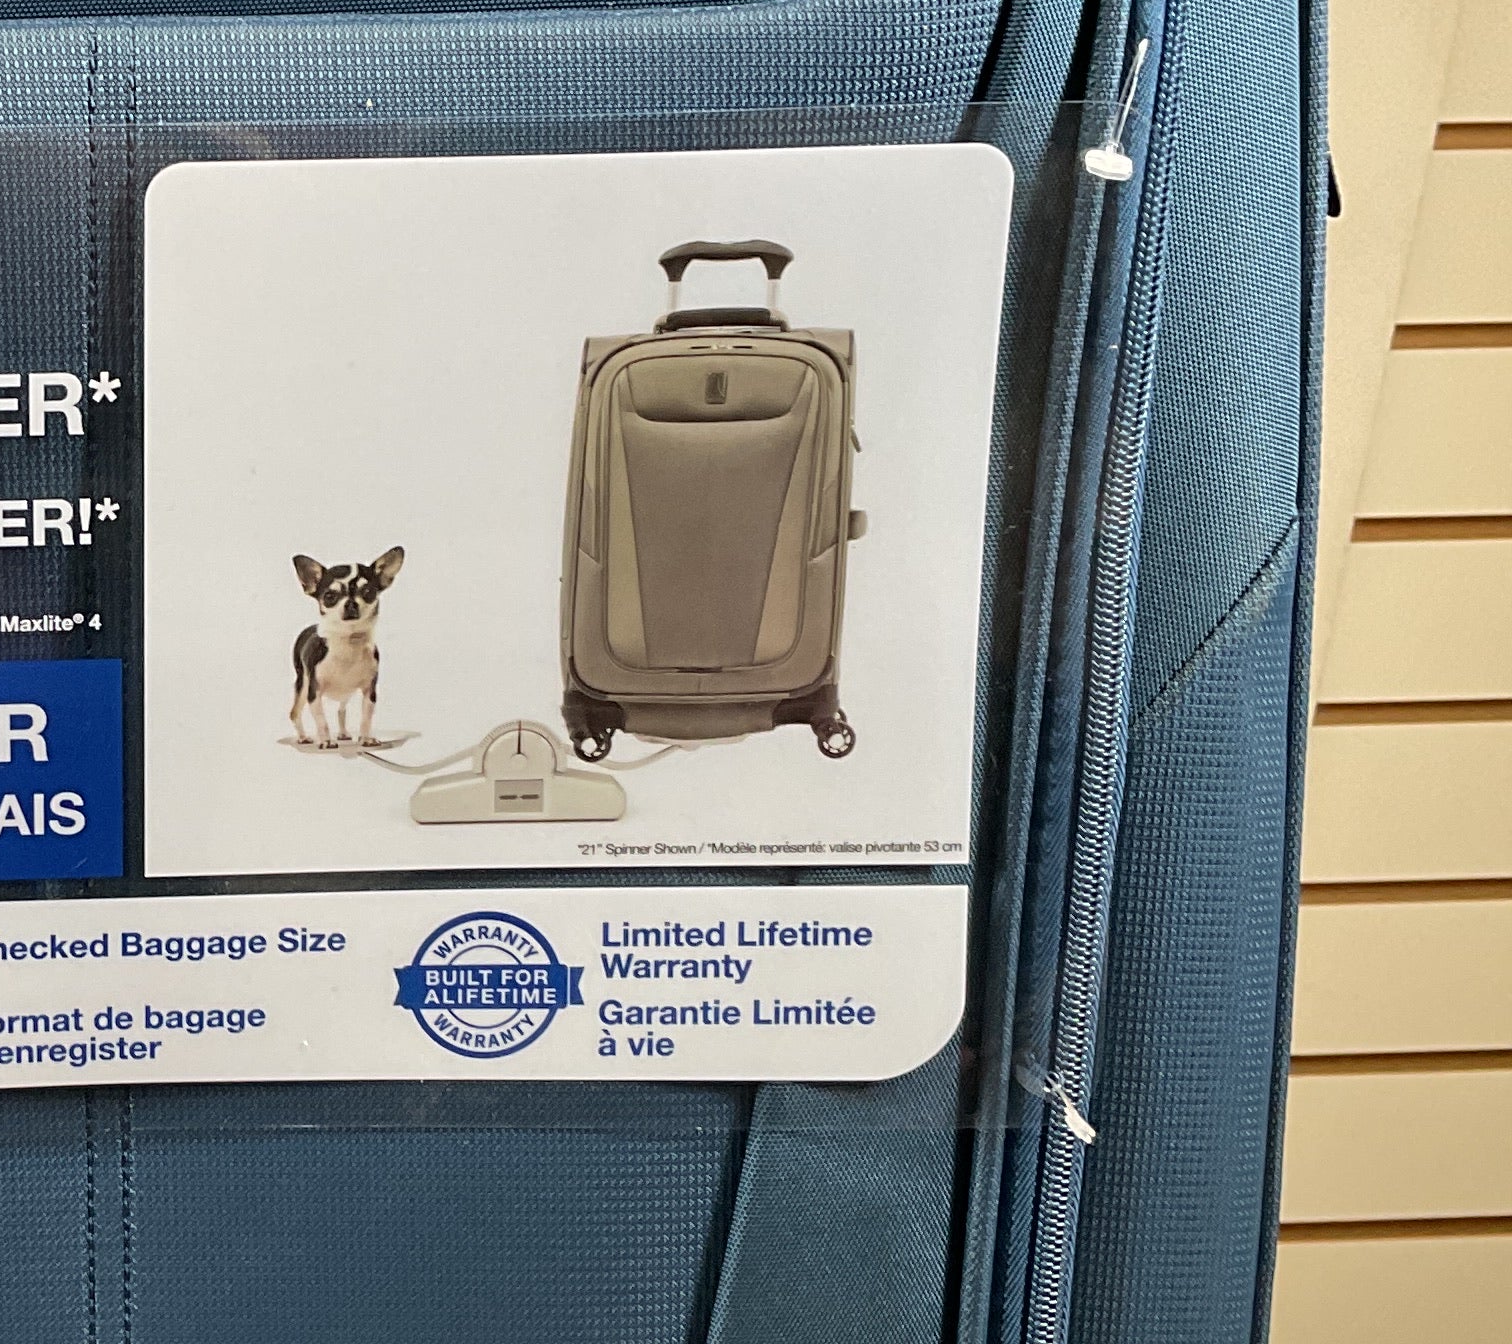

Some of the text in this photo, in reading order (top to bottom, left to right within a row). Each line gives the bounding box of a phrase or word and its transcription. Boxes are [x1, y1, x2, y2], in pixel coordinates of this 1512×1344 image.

[88, 614, 102, 630] 4
[605, 843, 651, 857] Spinner
[654, 843, 697, 854] Shown
[829, 841, 863, 853] valise
[865, 841, 921, 854] pivotante
[923, 841, 938, 852] 53
[942, 843, 962, 852] cm
[121, 932, 268, 961] Baggage
[277, 927, 347, 953] Size
[433, 925, 540, 959] WARRANTY
[602, 920, 873, 947] Limited Lifetime
[425, 969, 549, 986] BUILT FOR
[600, 953, 752, 984] Warranty
[93, 1005, 134, 1031] de
[144, 1005, 266, 1033] bagage
[598, 997, 876, 1026] Garantie Limitée
[433, 1013, 535, 1048] WARRANTY
[598, 1028, 675, 1056] à vie
